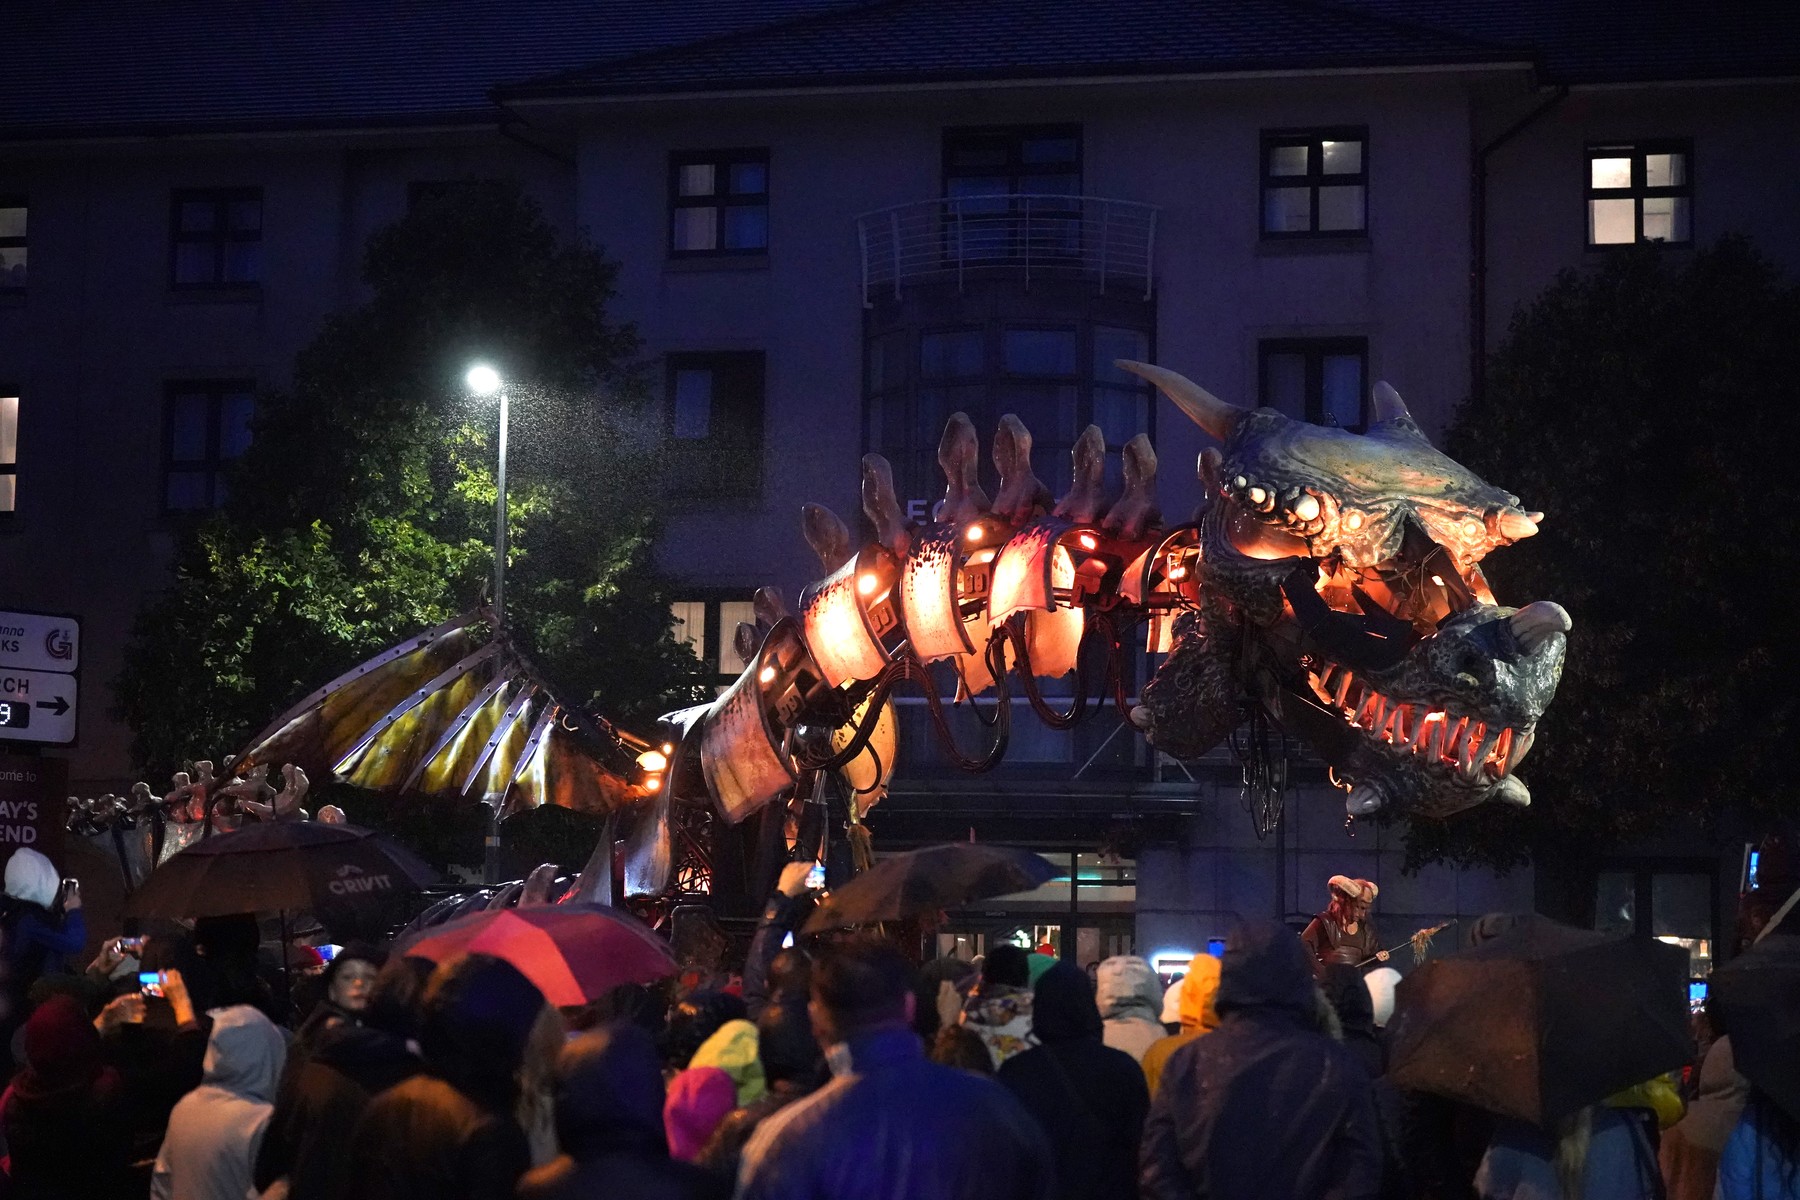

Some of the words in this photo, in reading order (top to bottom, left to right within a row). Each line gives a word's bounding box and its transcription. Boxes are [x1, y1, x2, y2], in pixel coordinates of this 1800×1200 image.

[0, 677, 29, 694] CH
[26, 771, 37, 782] to
[0, 800, 38, 820] AY'S
[328, 874, 392, 895] CRIVIT
